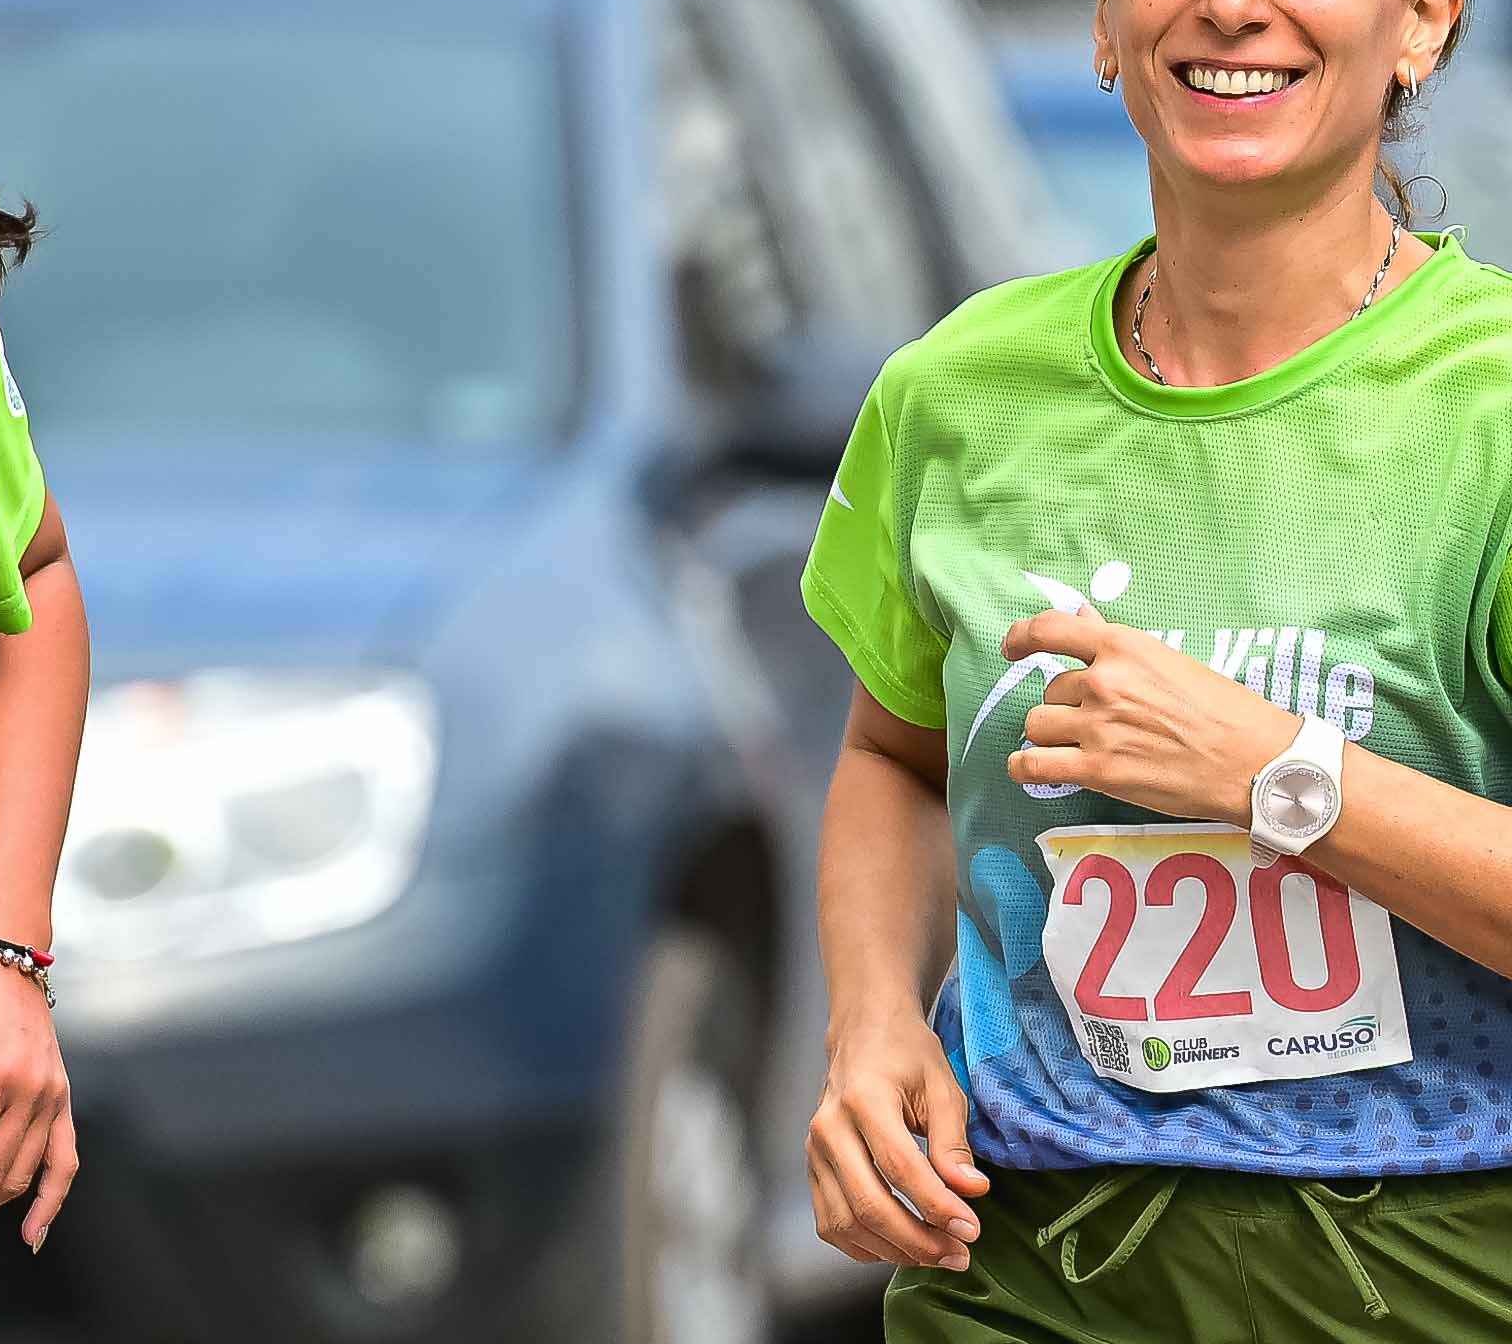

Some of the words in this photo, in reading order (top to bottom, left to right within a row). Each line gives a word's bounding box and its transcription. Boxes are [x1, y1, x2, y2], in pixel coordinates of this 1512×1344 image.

[1062, 853, 1362, 1022] 220
[1172, 1037, 1208, 1052] CLUB
[1268, 1028, 1375, 1056] CARUSO
[1172, 1045, 1240, 1065] RUNNER'S
